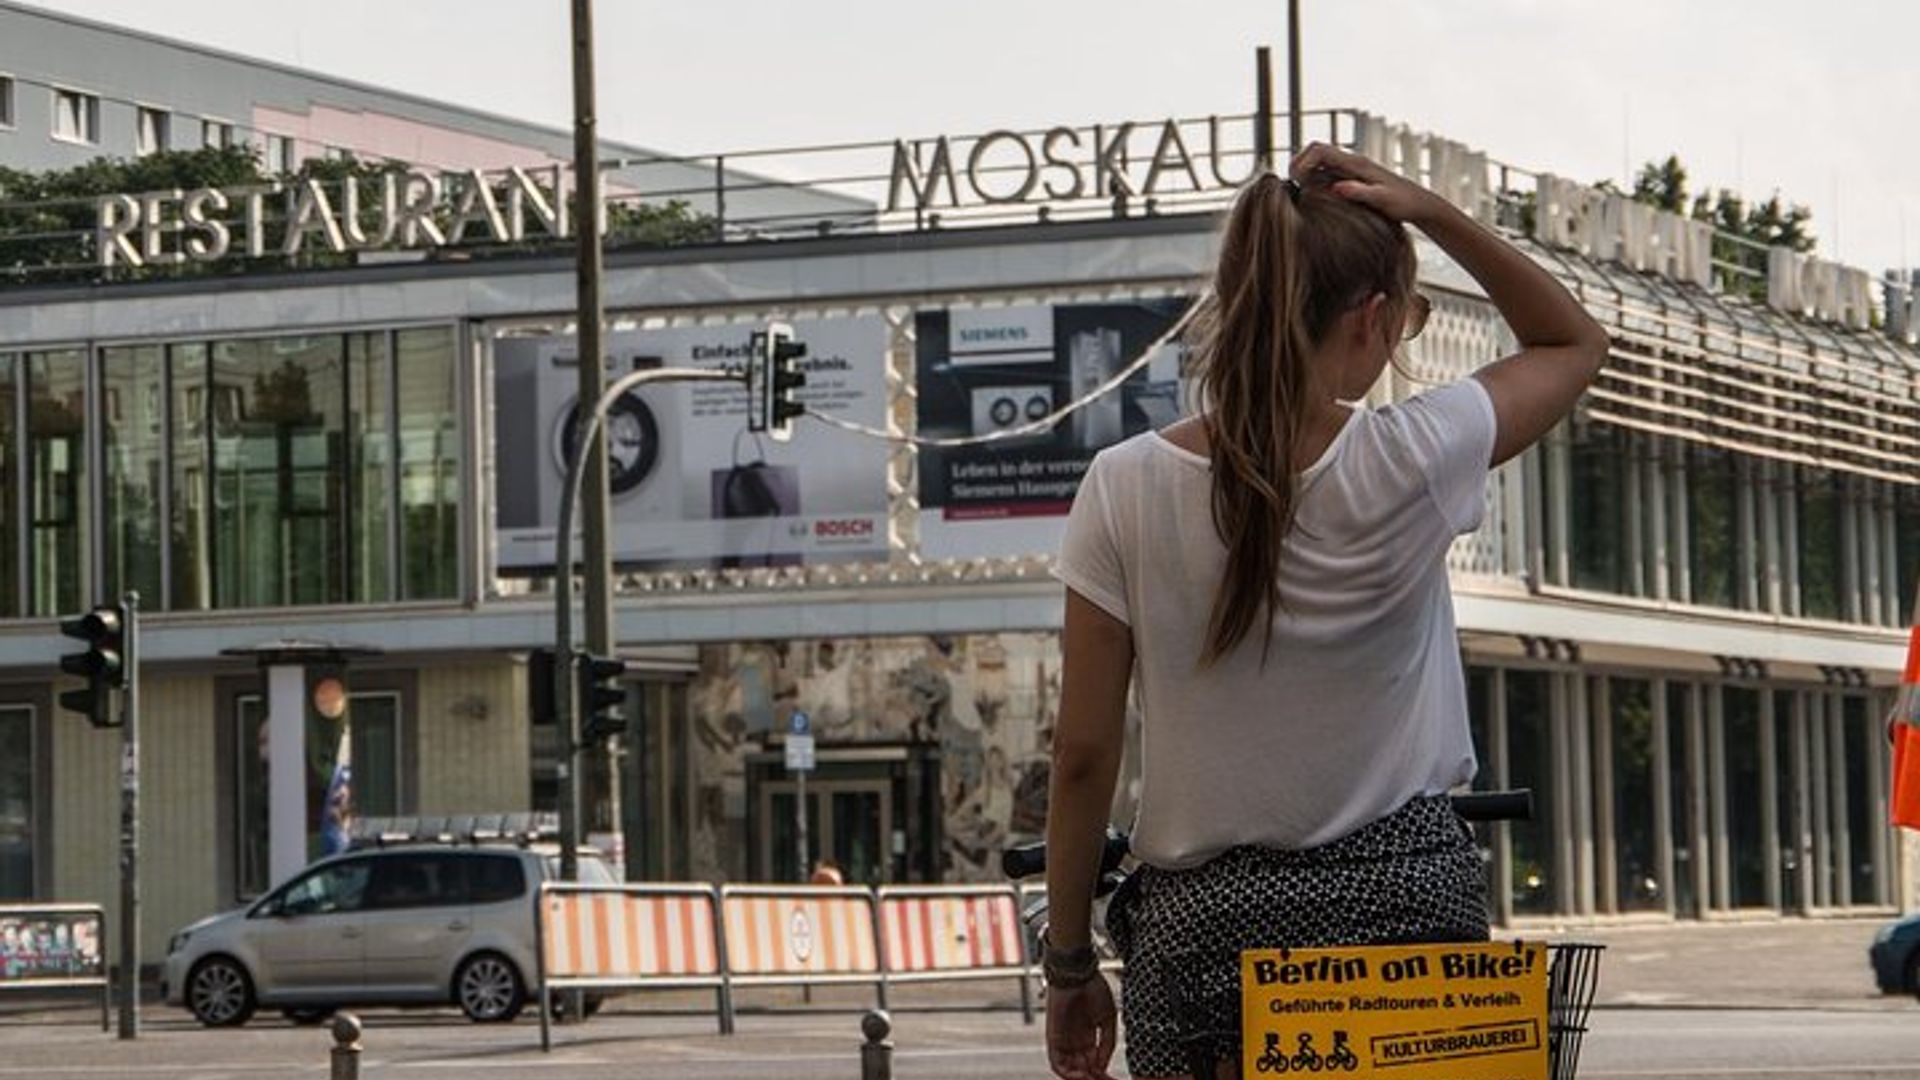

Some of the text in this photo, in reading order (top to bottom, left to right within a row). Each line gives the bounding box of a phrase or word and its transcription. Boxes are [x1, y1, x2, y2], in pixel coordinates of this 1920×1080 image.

[888, 114, 1260, 211] MOSKAU
[959, 326, 1029, 343] SIEMENS
[951, 462, 998, 478] Leben
[1000, 460, 1017, 477] in
[1019, 459, 1043, 475] der
[951, 483, 1016, 498] Siemens
[814, 519, 874, 537] BOSCH
[1254, 942, 1536, 985] Berlin on Bike!
[1269, 990, 1521, 1014] Geführte Radtouren & Verleih
[1383, 1028, 1527, 1060] KULTURBRAUEREI
